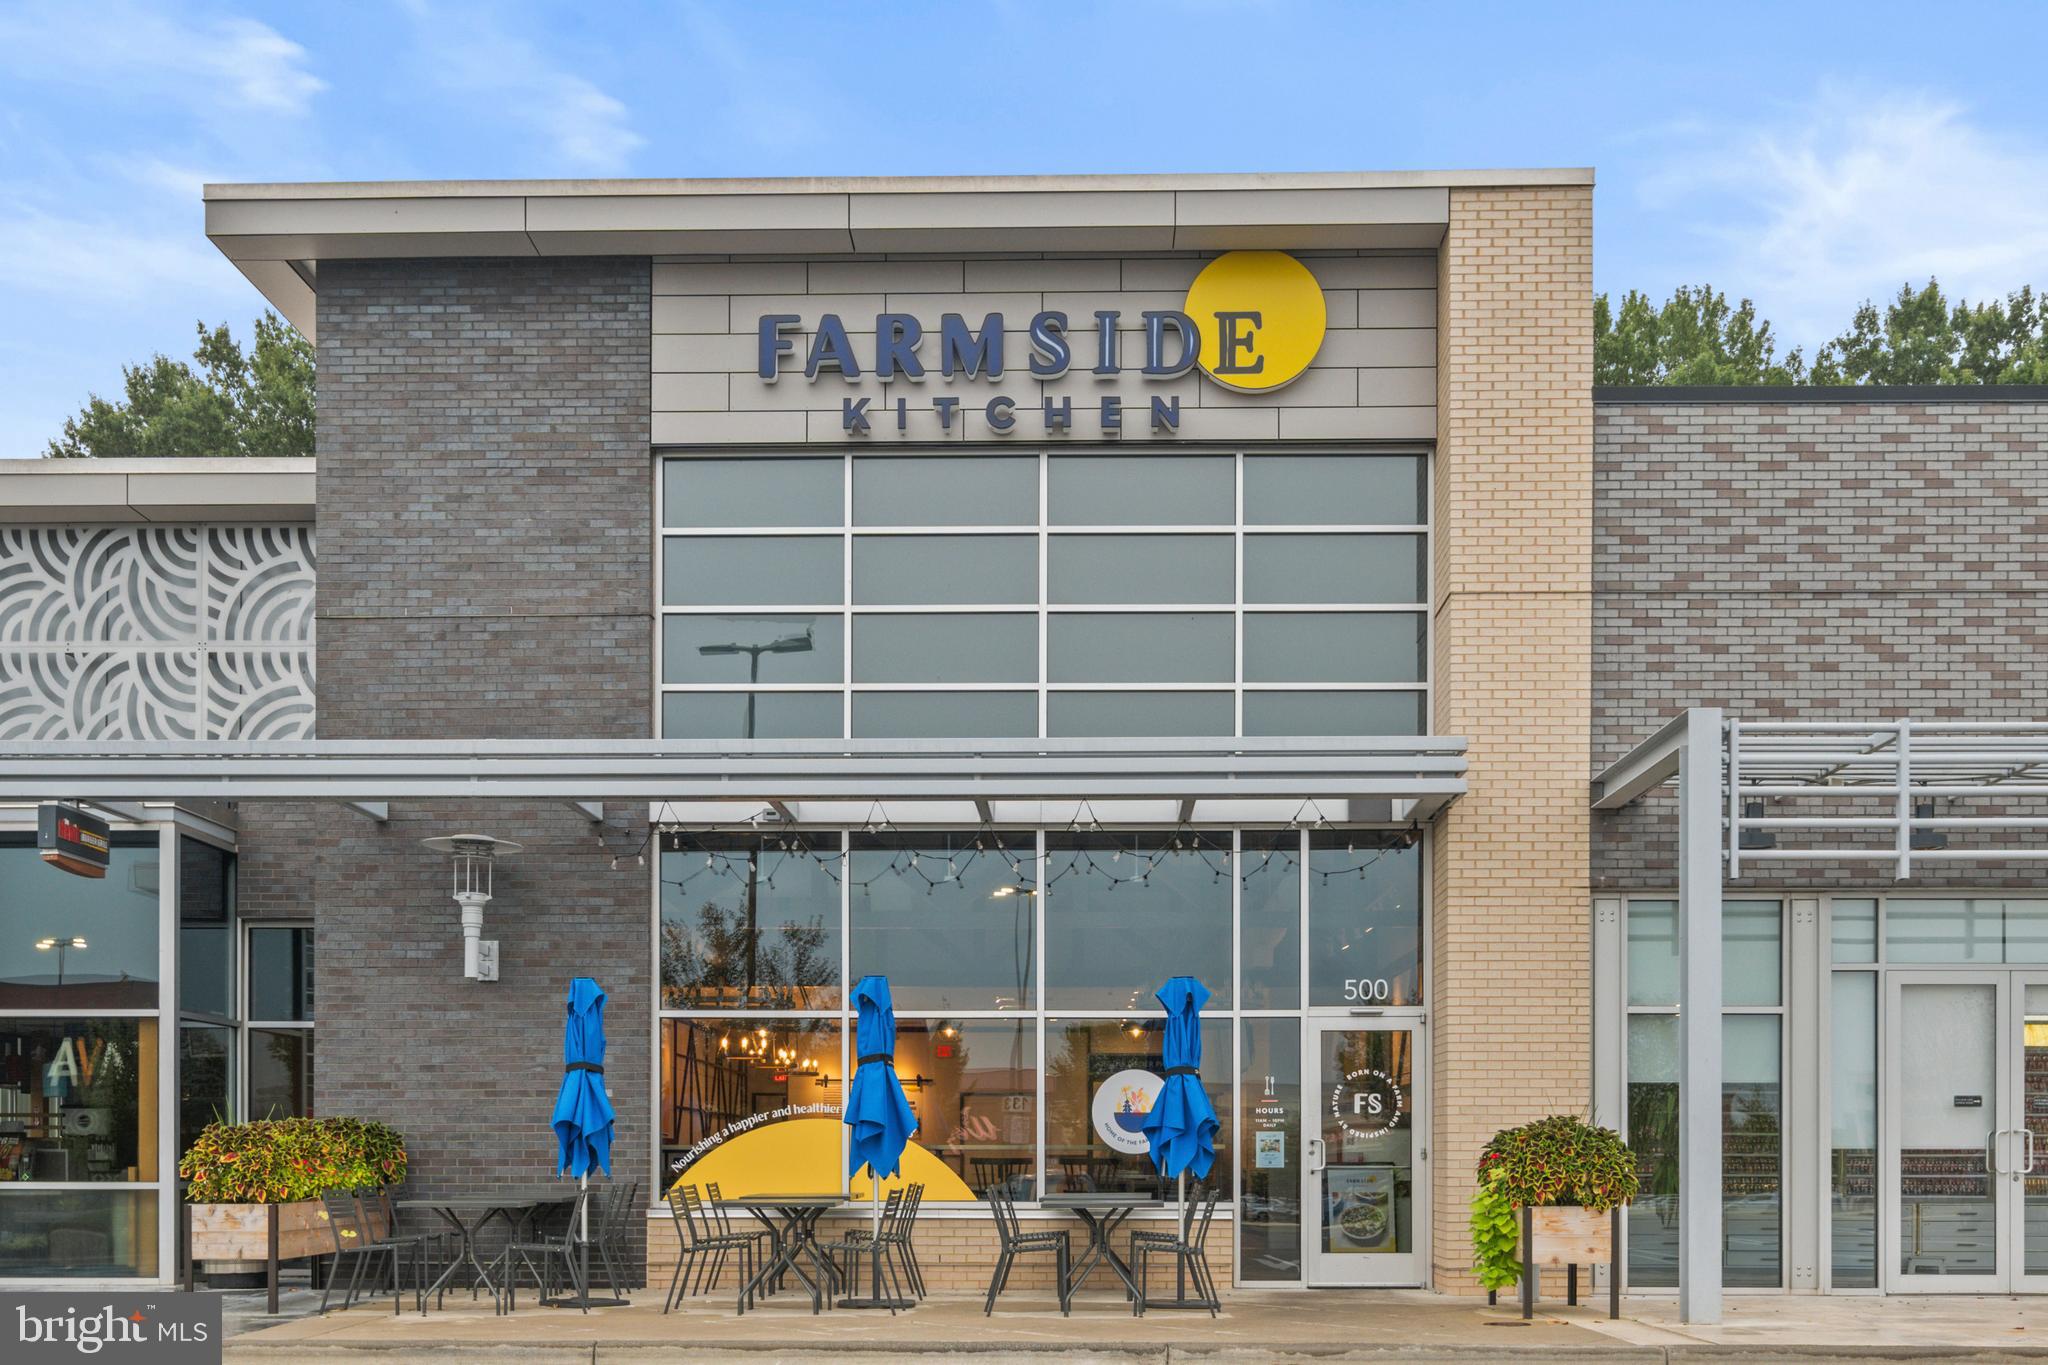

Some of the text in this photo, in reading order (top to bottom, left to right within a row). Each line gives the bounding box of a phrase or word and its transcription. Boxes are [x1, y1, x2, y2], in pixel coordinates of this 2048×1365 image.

[757, 309, 1264, 384] FARMSIDE
[842, 396, 1181, 436] KITCHEN
[1344, 978, 1389, 1001] 500
[1346, 1068, 1370, 1080] BORN
[1372, 1070, 1386, 1079] ON
[1332, 1084, 1343, 1118] NATURE
[1353, 1092, 1382, 1114] FS
[1338, 1120, 1349, 1130] BY
[1389, 1110, 1401, 1127] AND
[671, 1102, 843, 1174] Nourishing a happier and healthier
[1349, 1127, 1389, 1139] INSPIRED
